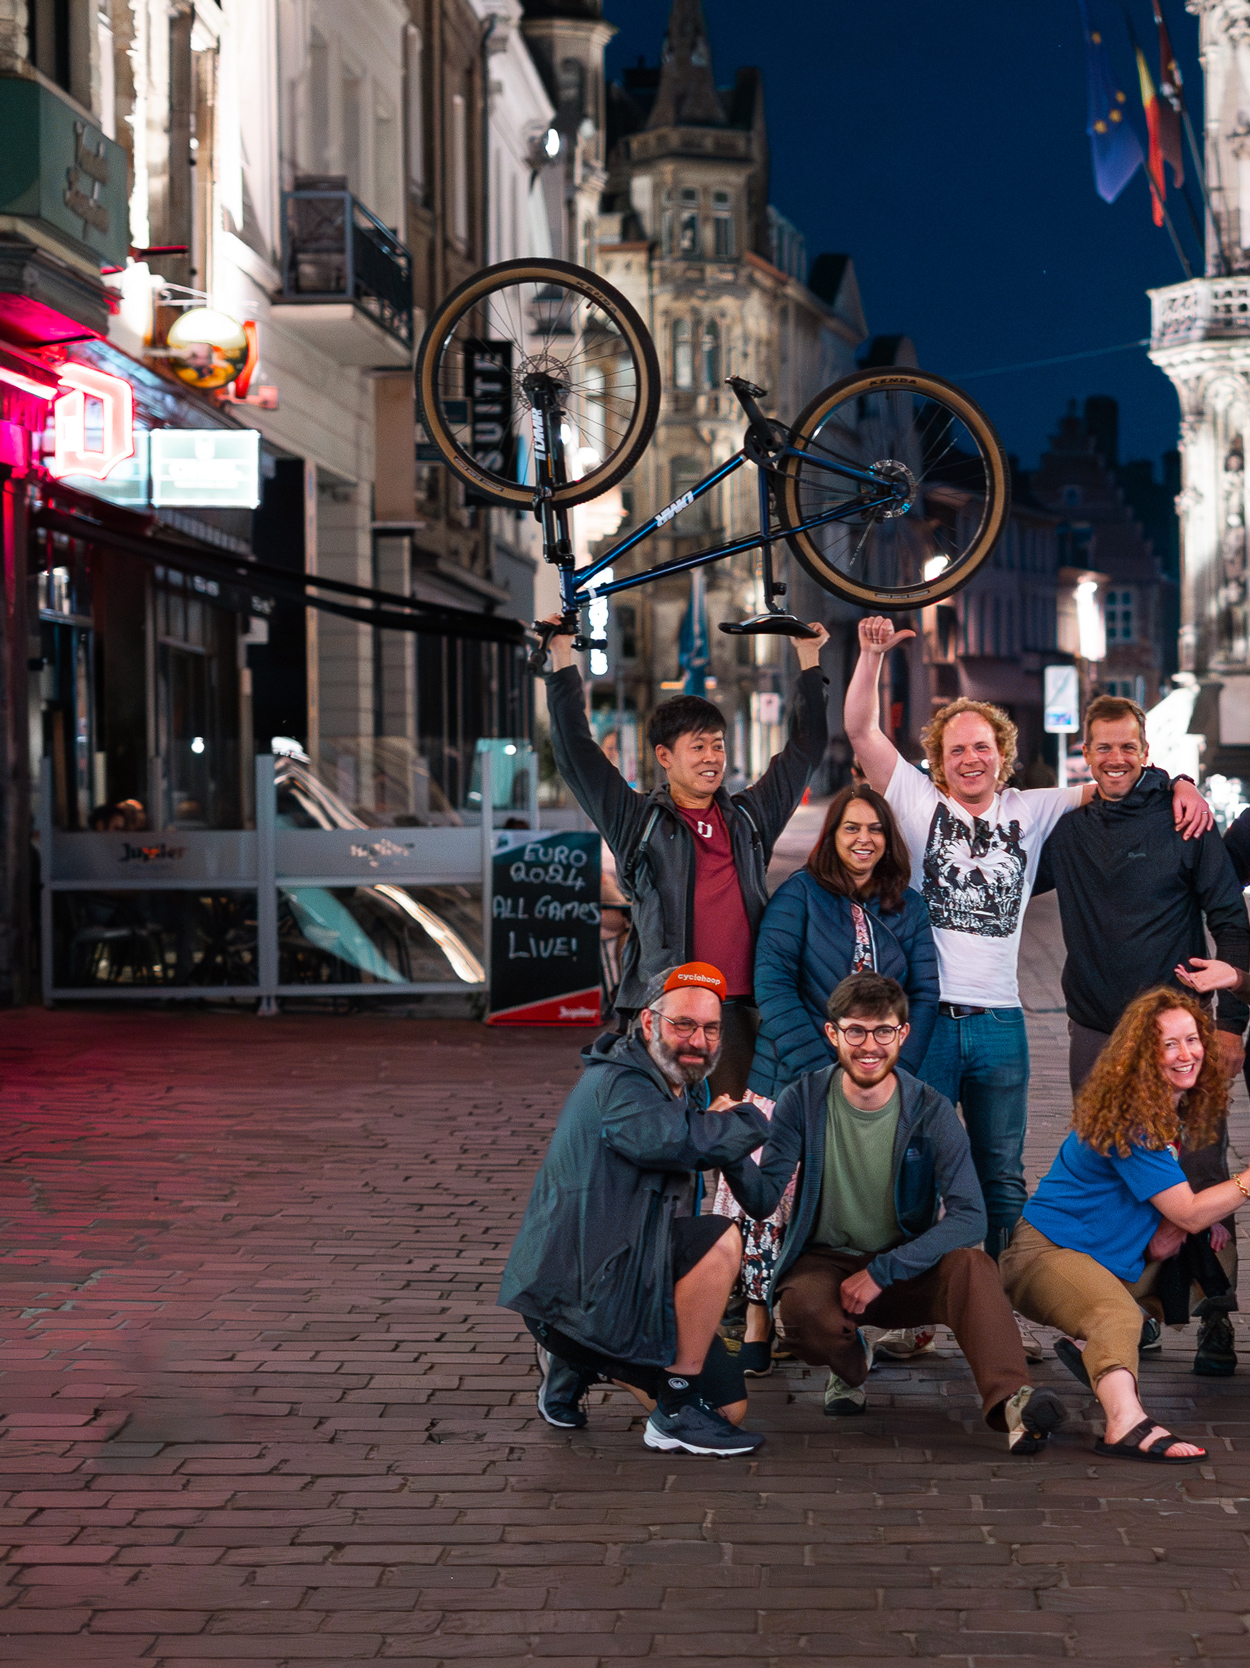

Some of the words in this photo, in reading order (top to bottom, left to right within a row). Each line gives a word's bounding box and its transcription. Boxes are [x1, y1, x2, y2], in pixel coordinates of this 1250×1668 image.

[869, 377, 917, 386] KENDA
[474, 351, 504, 471] SUITE
[523, 842, 588, 868] EURO
[510, 861, 586, 892] 2024
[493, 895, 529, 920] ALL
[677, 973, 721, 986] cyclehoop
